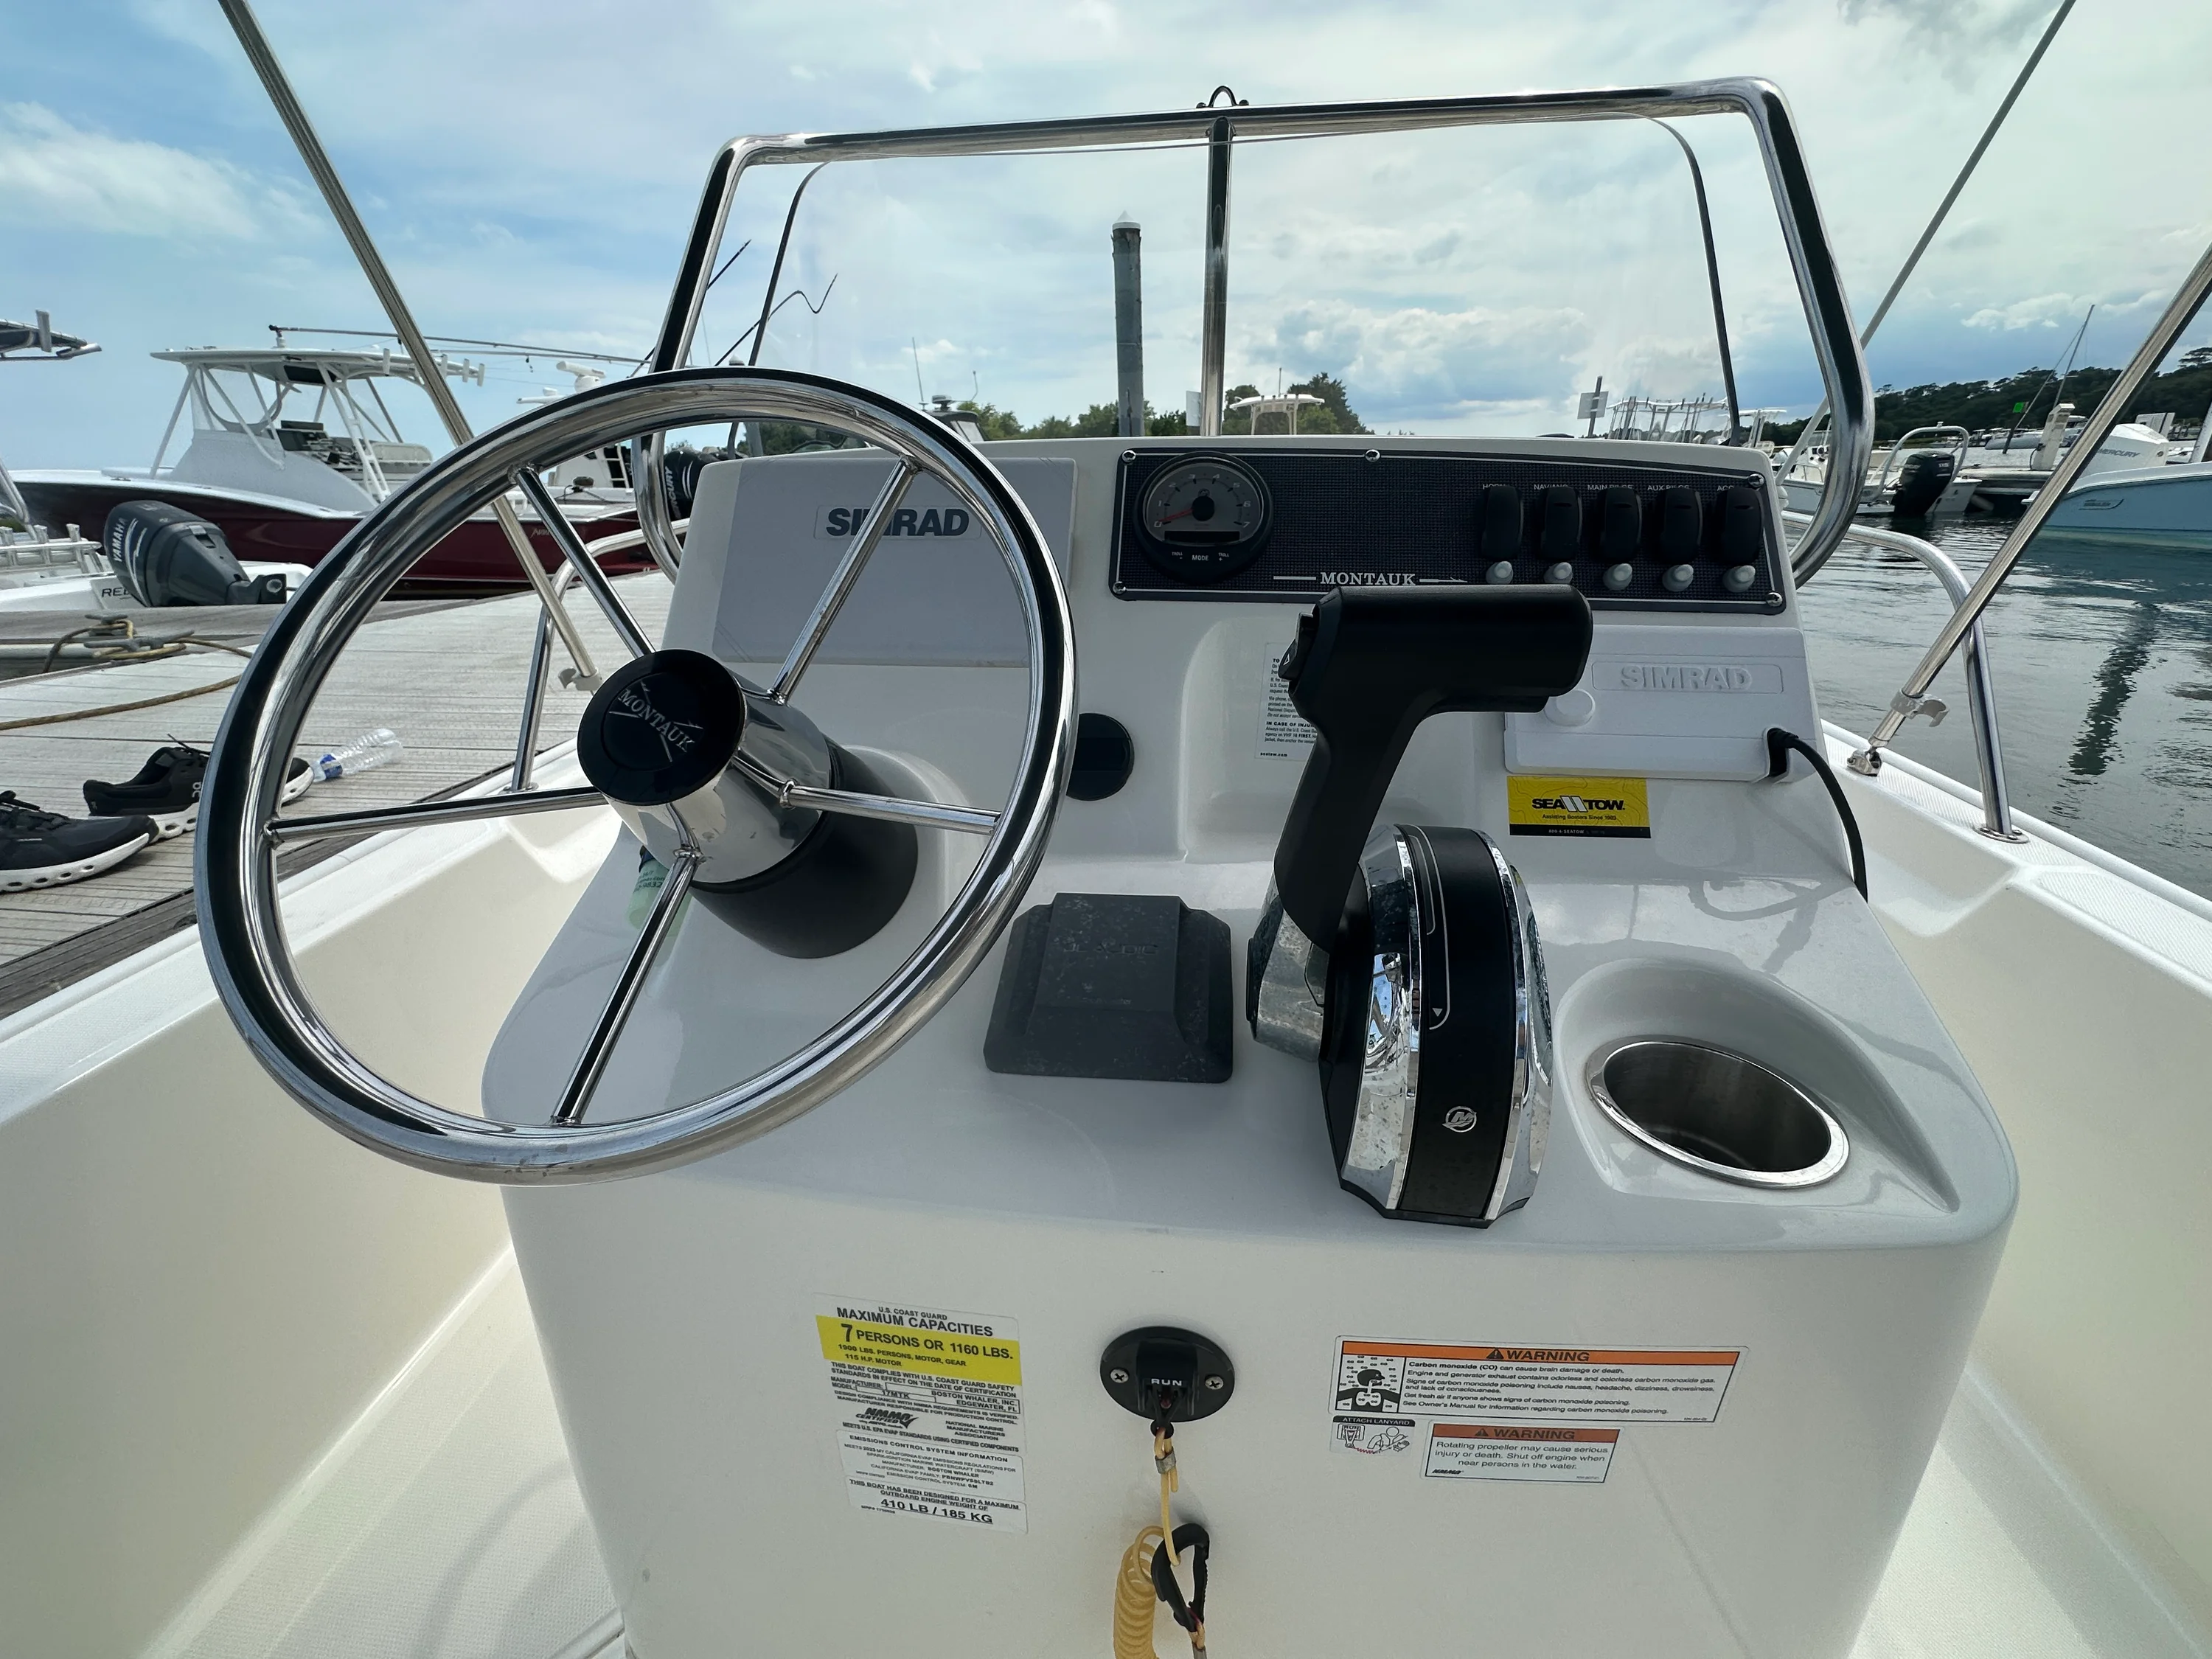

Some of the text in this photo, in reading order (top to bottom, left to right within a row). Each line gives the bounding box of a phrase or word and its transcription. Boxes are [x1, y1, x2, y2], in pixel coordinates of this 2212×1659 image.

[826, 508, 969, 536] SIRAD
[112, 518, 128, 562] YAMAHA
[1320, 572, 1416, 585] MONTAUK
[1621, 665, 1752, 690] SIMRAD
[618, 689, 695, 753] MONTAUK
[1532, 799, 1565, 810] SEA
[837, 1307, 993, 1336] MAXIMUM CAPACITIES
[894, 1309, 918, 1317] COAST
[841, 1324, 1013, 1359] 7 PERSONS OR 1160 LBS.
[838, 1343, 857, 1352] 1900
[877, 1350, 913, 1360] PERSONS,
[916, 1355, 943, 1364] MOTOR,
[945, 1358, 966, 1366] GEAR
[876, 1358, 902, 1366] MOTOR
[1507, 1350, 1590, 1361] WARNING
[867, 1367, 901, 1377] COMPLIES
[831, 1368, 871, 1379] STANDARDS
[881, 1375, 905, 1383] EFFECT
[934, 1382, 952, 1391] DATE
[964, 1388, 1016, 1398] CERTIFICATION
[1151, 1378, 1182, 1386] RUN
[931, 1391, 962, 1399] BOSTON
[965, 1395, 1000, 1405] WHALER,
[956, 1400, 1006, 1411] EDGEWATER,
[1494, 1429, 1575, 1439] WARNING
[849, 1435, 1007, 1462] EMISSIONS CONTROL SYSTEM INFORMATION
[1436, 1441, 1474, 1450] Rotating
[849, 1478, 865, 1486] THIS
[924, 1492, 959, 1500] DESIGNED
[984, 1500, 1018, 1509] MAXIMUM
[880, 1490, 919, 1500] OUTBOARD
[921, 1496, 947, 1504] ENGINE
[950, 1500, 976, 1509] WEIGHT
[881, 1498, 905, 1509] 410
[909, 1503, 928, 1513] LB
[942, 1509, 966, 1519] 185
[970, 1512, 992, 1523] KG
